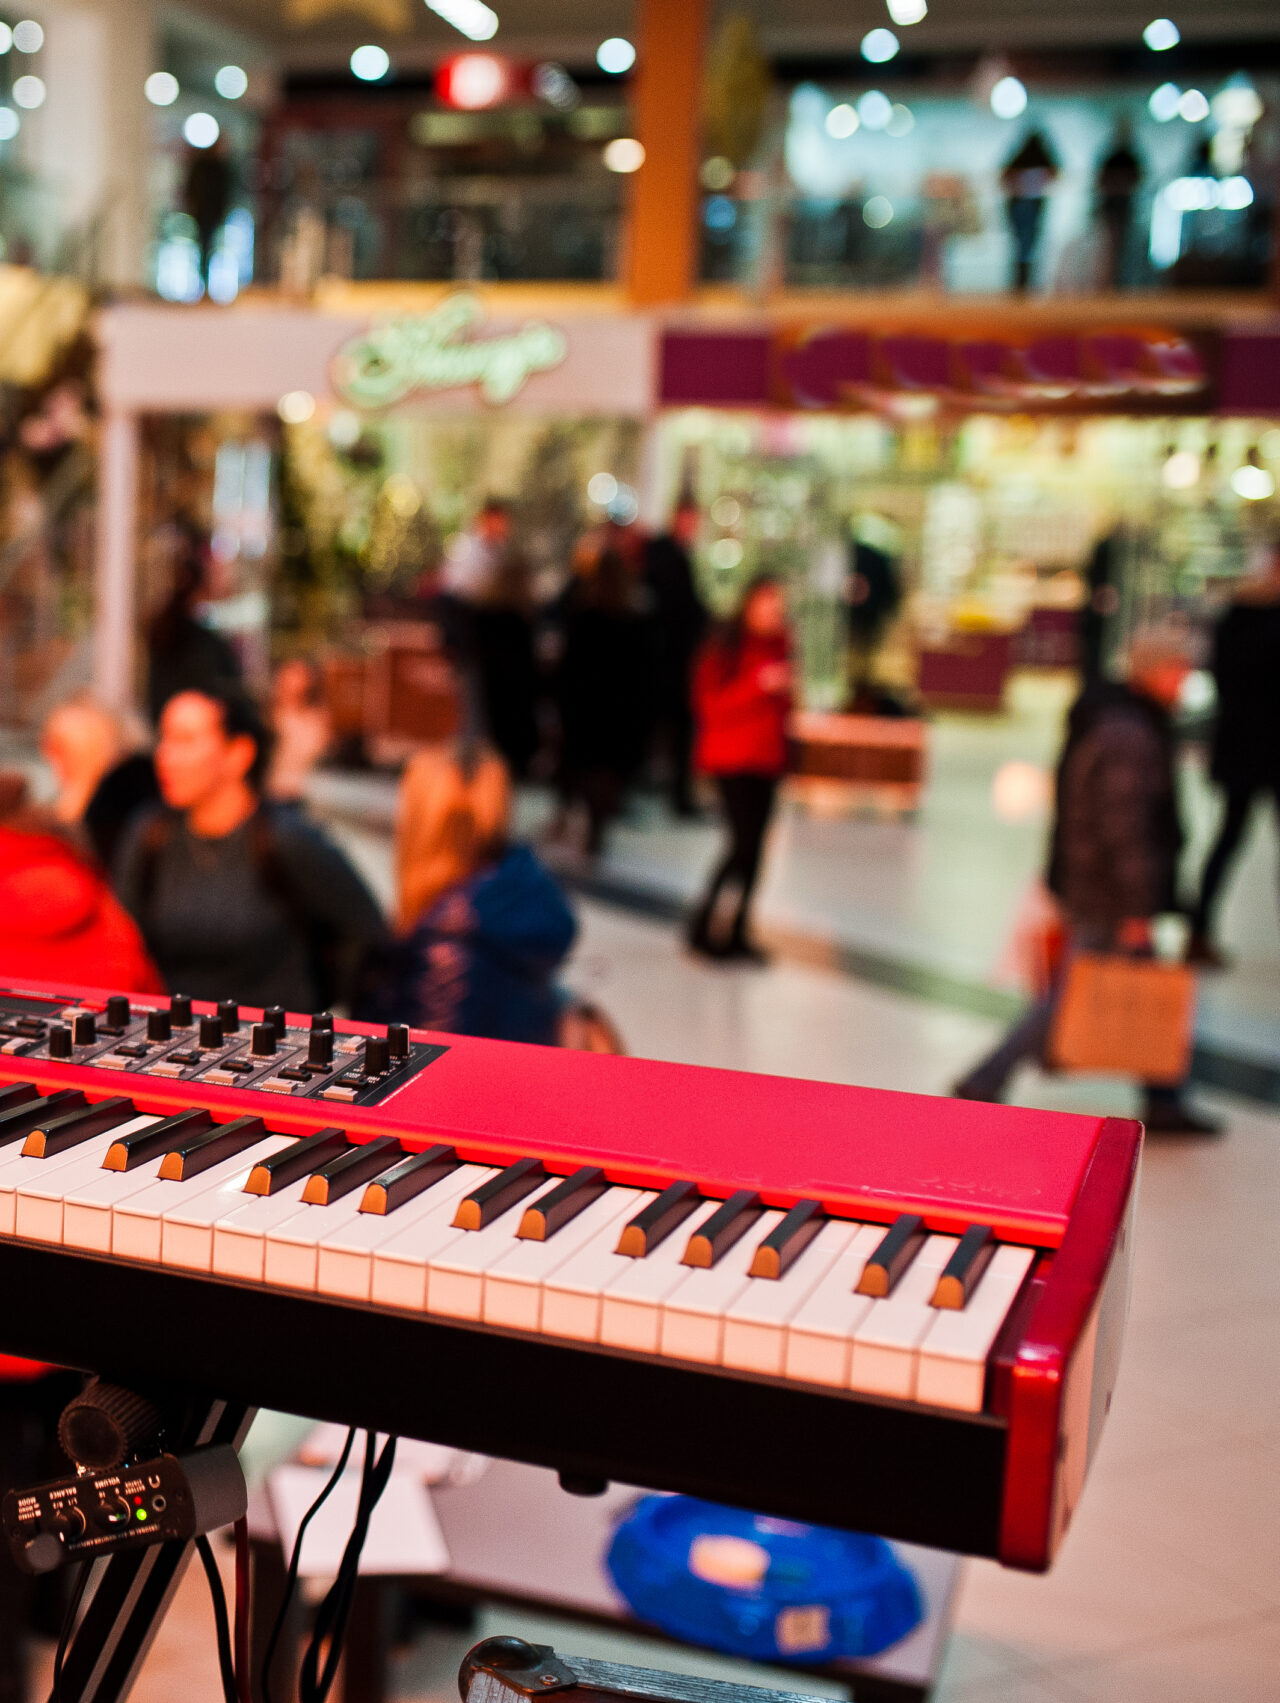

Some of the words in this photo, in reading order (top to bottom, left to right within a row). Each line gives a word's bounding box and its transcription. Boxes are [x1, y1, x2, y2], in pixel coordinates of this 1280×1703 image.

[94, 1476, 121, 1490] VOLUME
[49, 1486, 77, 1500] BALANCE
[18, 1496, 37, 1507] MODE
